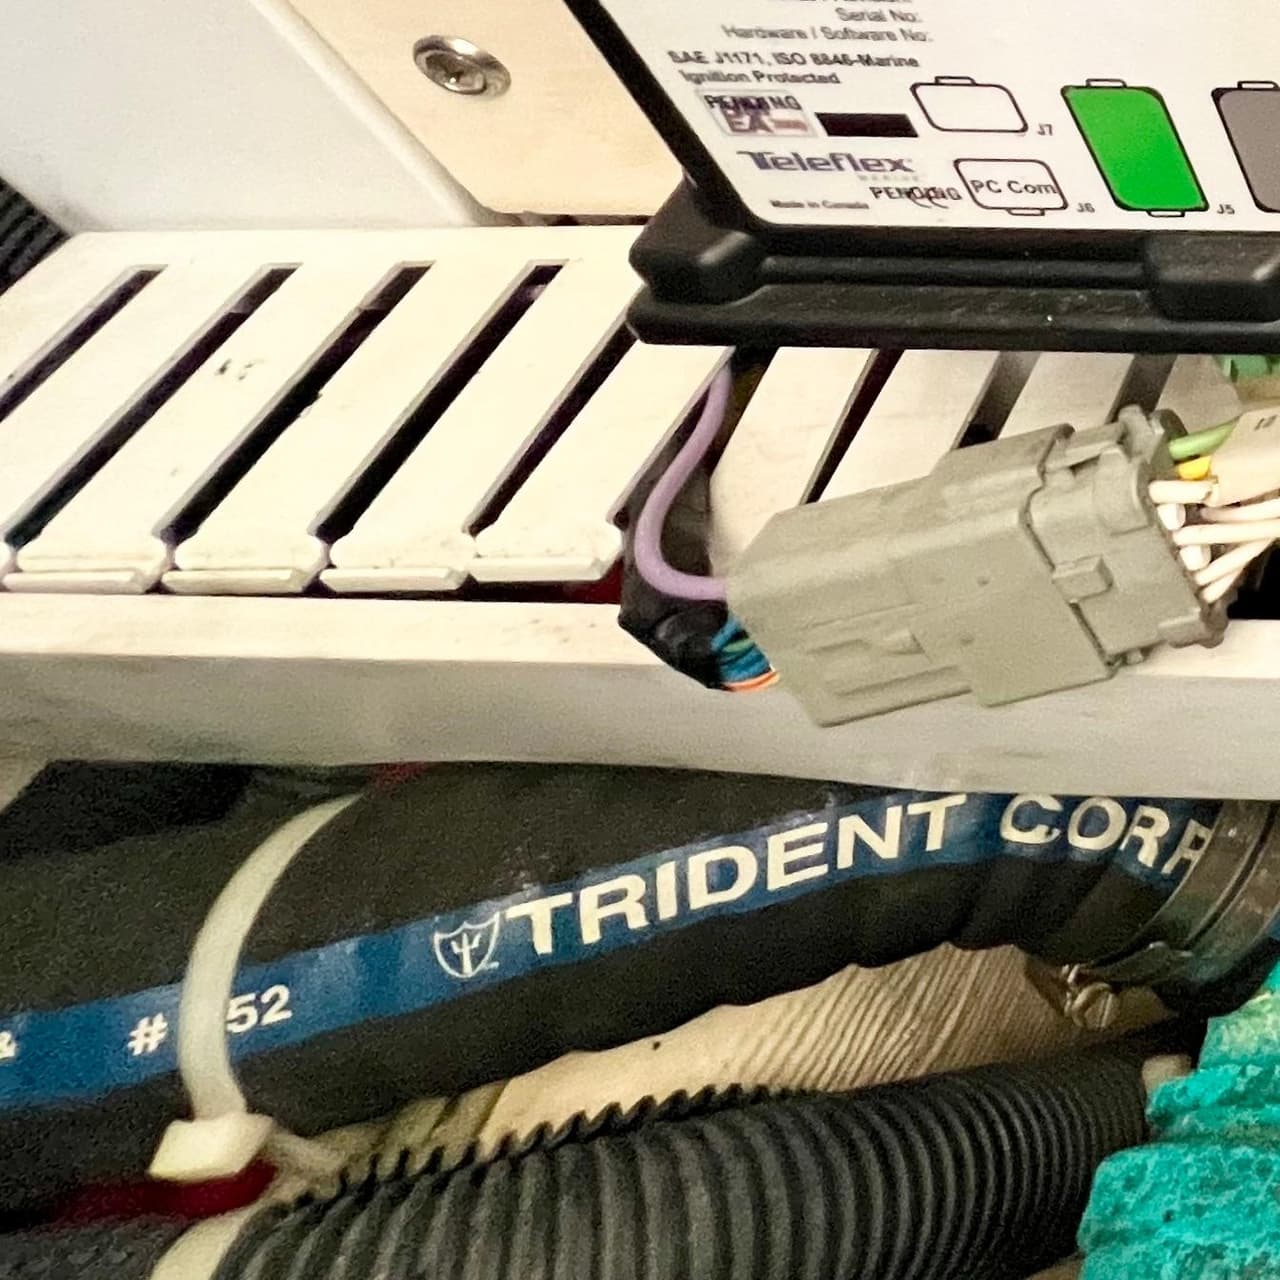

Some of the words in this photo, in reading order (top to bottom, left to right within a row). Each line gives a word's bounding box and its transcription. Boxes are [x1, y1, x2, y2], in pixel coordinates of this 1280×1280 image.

[834, 7, 888, 22] Serial
[666, 51, 710, 65] SAE
[773, 52, 807, 66] ISO
[678, 70, 750, 85] Ignition
[753, 71, 841, 85] Protected
[1036, 123, 1054, 137] J7
[736, 151, 916, 172] Teleflex
[969, 178, 1004, 195] PC
[1007, 179, 1059, 196] Com
[1076, 202, 1096, 214] J6
[1216, 203, 1236, 215] J5
[506, 794, 969, 956] TRIDENT
